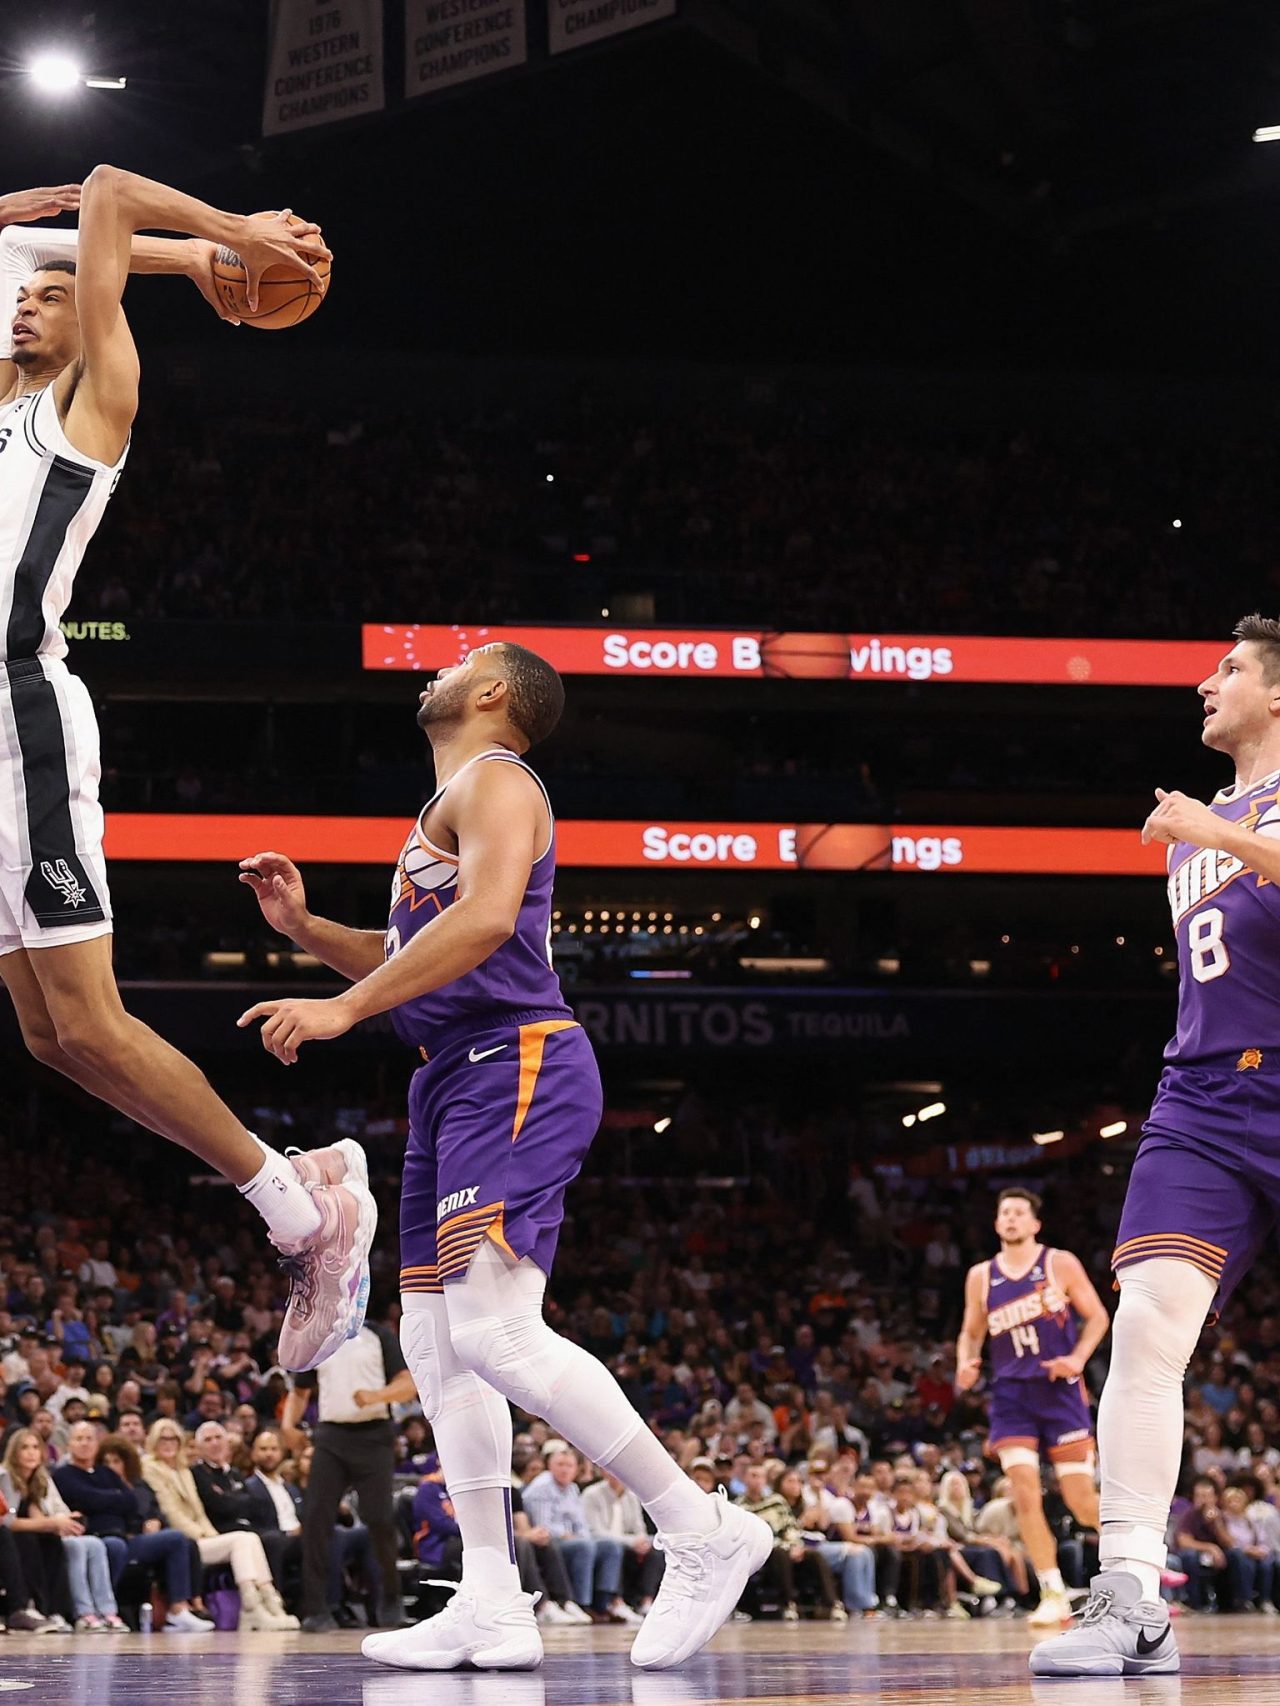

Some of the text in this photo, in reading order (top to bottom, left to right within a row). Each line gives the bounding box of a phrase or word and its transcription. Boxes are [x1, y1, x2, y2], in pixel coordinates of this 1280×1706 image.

[308, 10, 341, 34] 1976
[415, 8, 514, 56] CONFERENCE
[287, 33, 360, 66] WESTERN
[420, 38, 511, 82] CHAMPIONS
[274, 55, 374, 97] CONFERENCE
[278, 85, 369, 121] CHAMPIONS
[603, 634, 718, 670] Score
[642, 826, 757, 862] Score
[1188, 907, 1231, 984] 8
[786, 1011, 912, 1038] TEQUILA
[987, 1292, 1043, 1337] SUNS
[1010, 1324, 1040, 1358] 14
